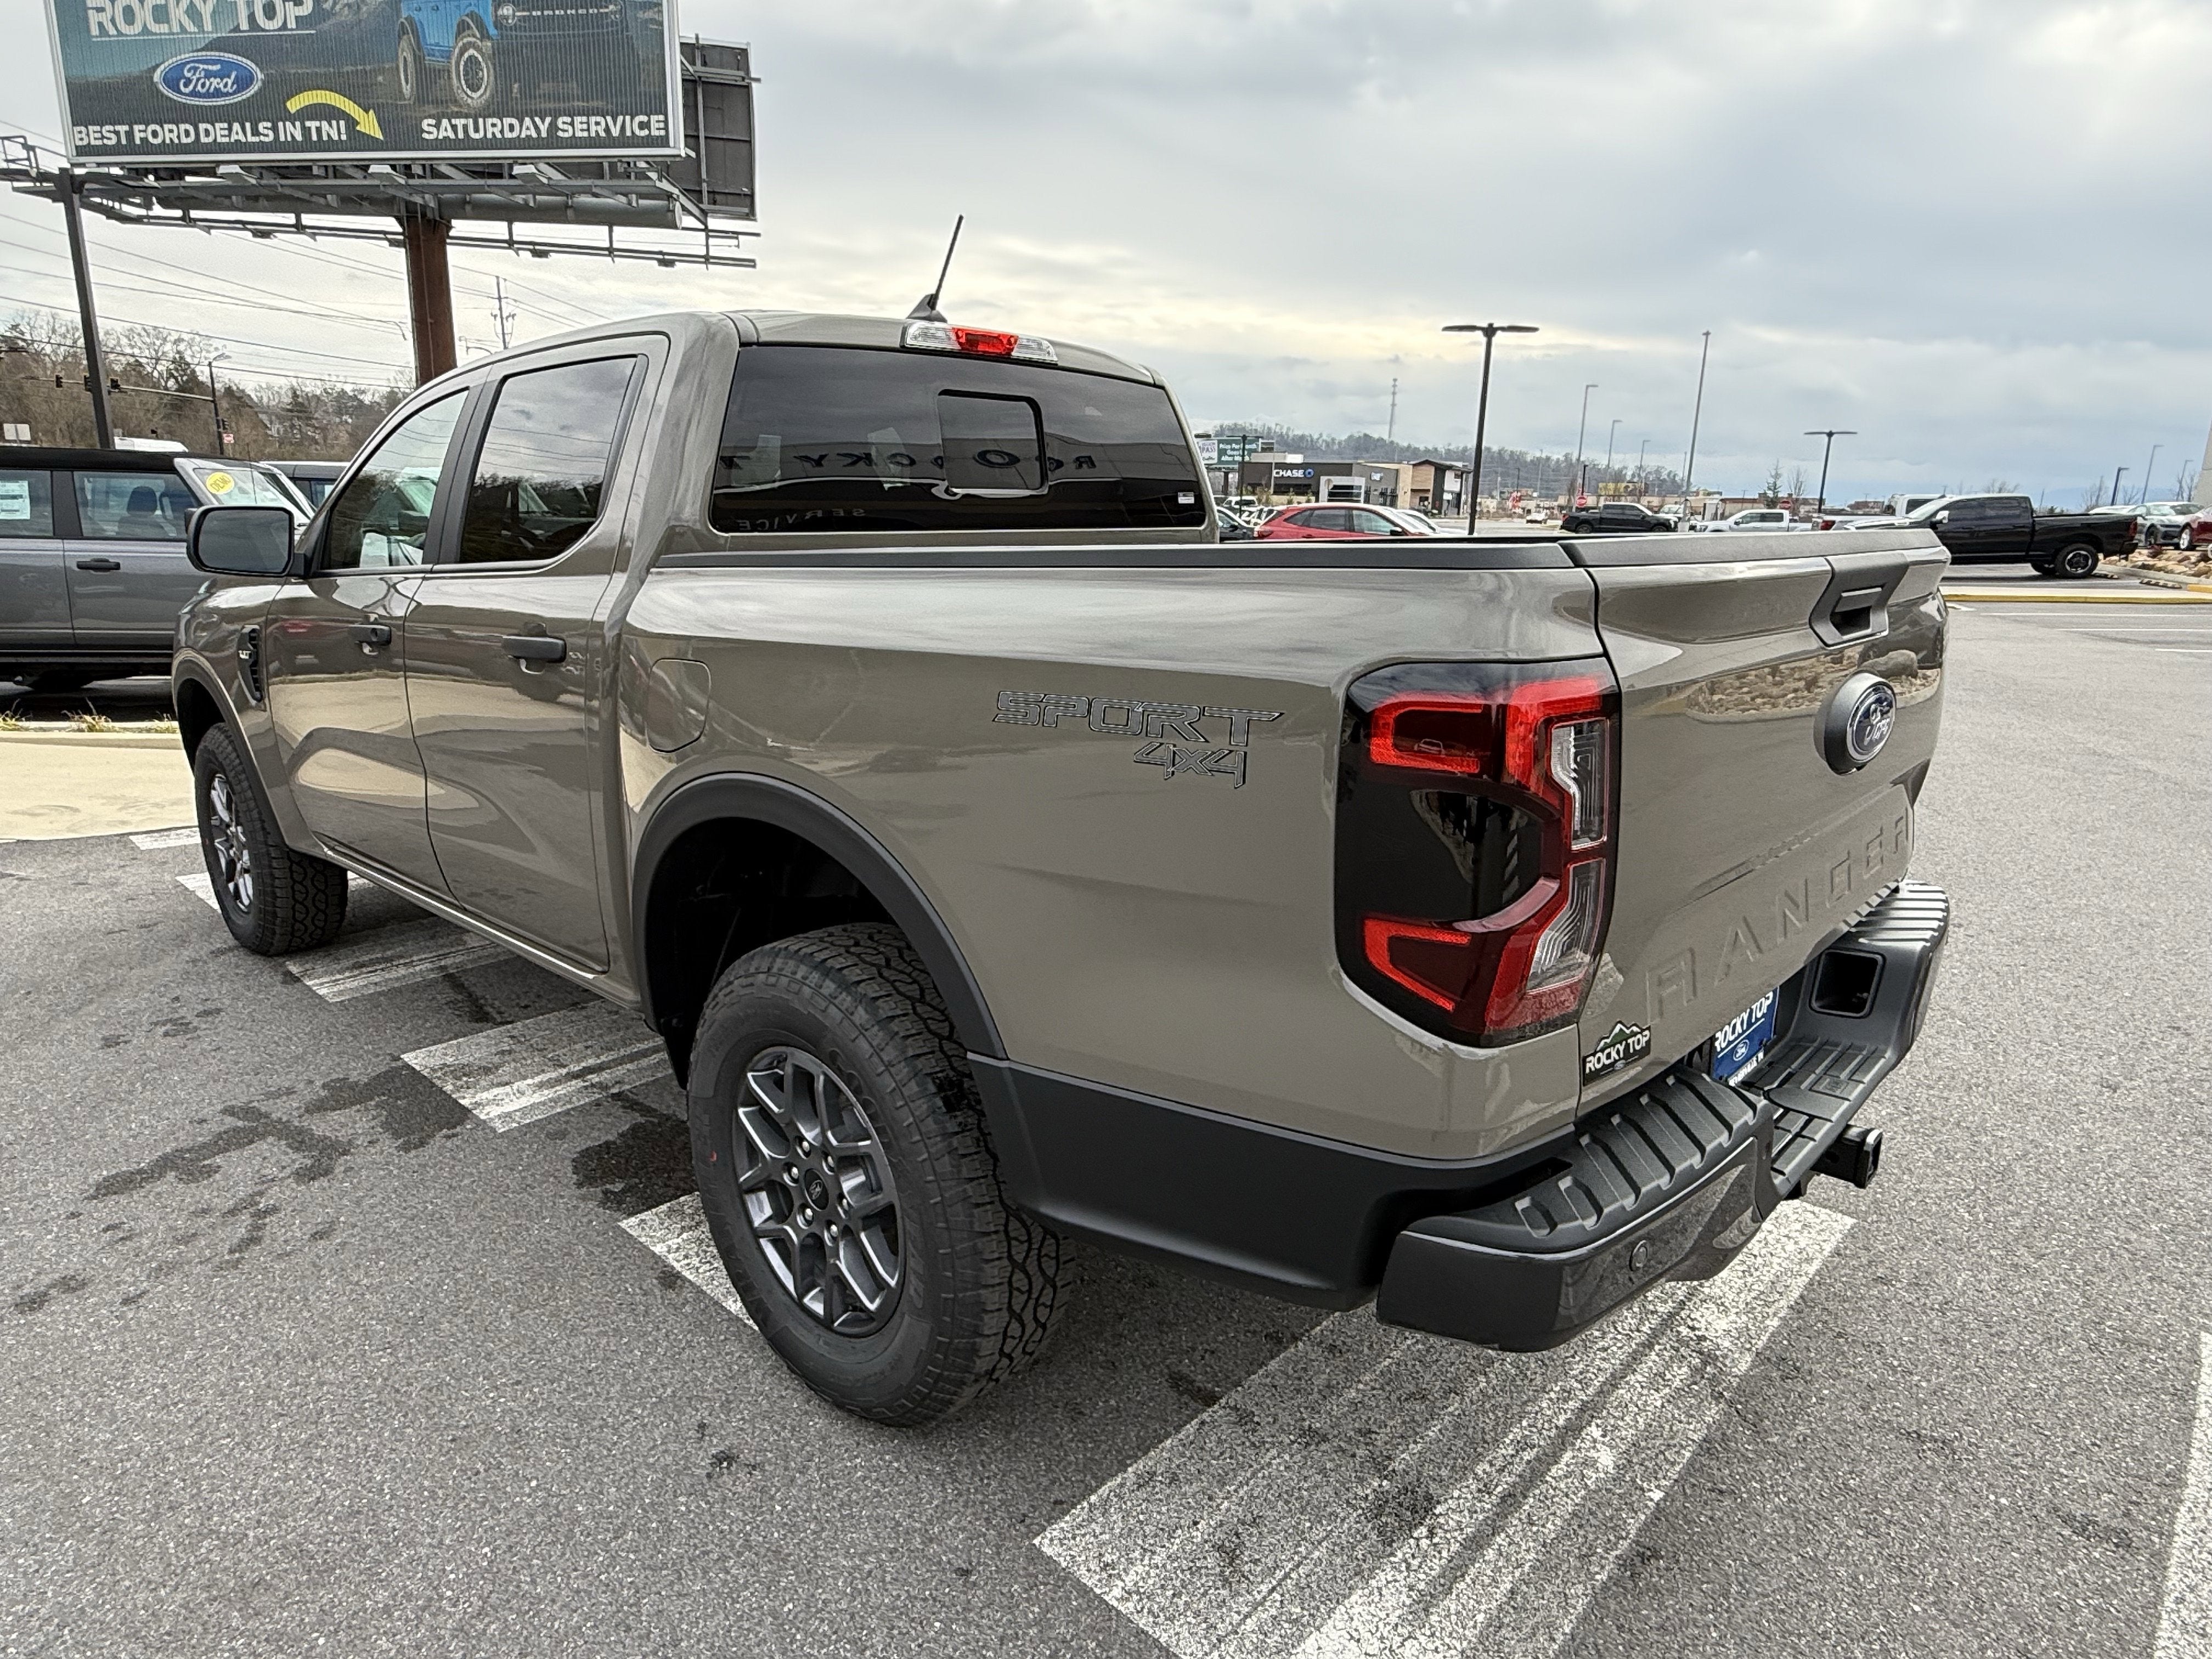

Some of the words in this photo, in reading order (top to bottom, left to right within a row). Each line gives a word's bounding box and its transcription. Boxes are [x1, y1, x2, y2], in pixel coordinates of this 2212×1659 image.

[86, 0, 216, 36] ROCKY
[228, 0, 314, 31] TOP
[179, 63, 238, 94] Ford
[74, 124, 130, 146] BEST
[133, 122, 197, 145] FORD
[200, 121, 274, 144] DEALS
[279, 121, 301, 142] IN
[301, 120, 347, 141] TN!
[421, 116, 552, 140] SATURDAY
[556, 114, 666, 138] SERVICE
[1273, 469, 1305, 478] CHASE
[991, 690, 1285, 747] SPORT
[1714, 1008, 1751, 1052] ROCKY
[1751, 990, 1774, 1024] TOP
[1585, 1040, 1626, 1074] ROCKY
[1627, 1030, 1650, 1053] TOP
